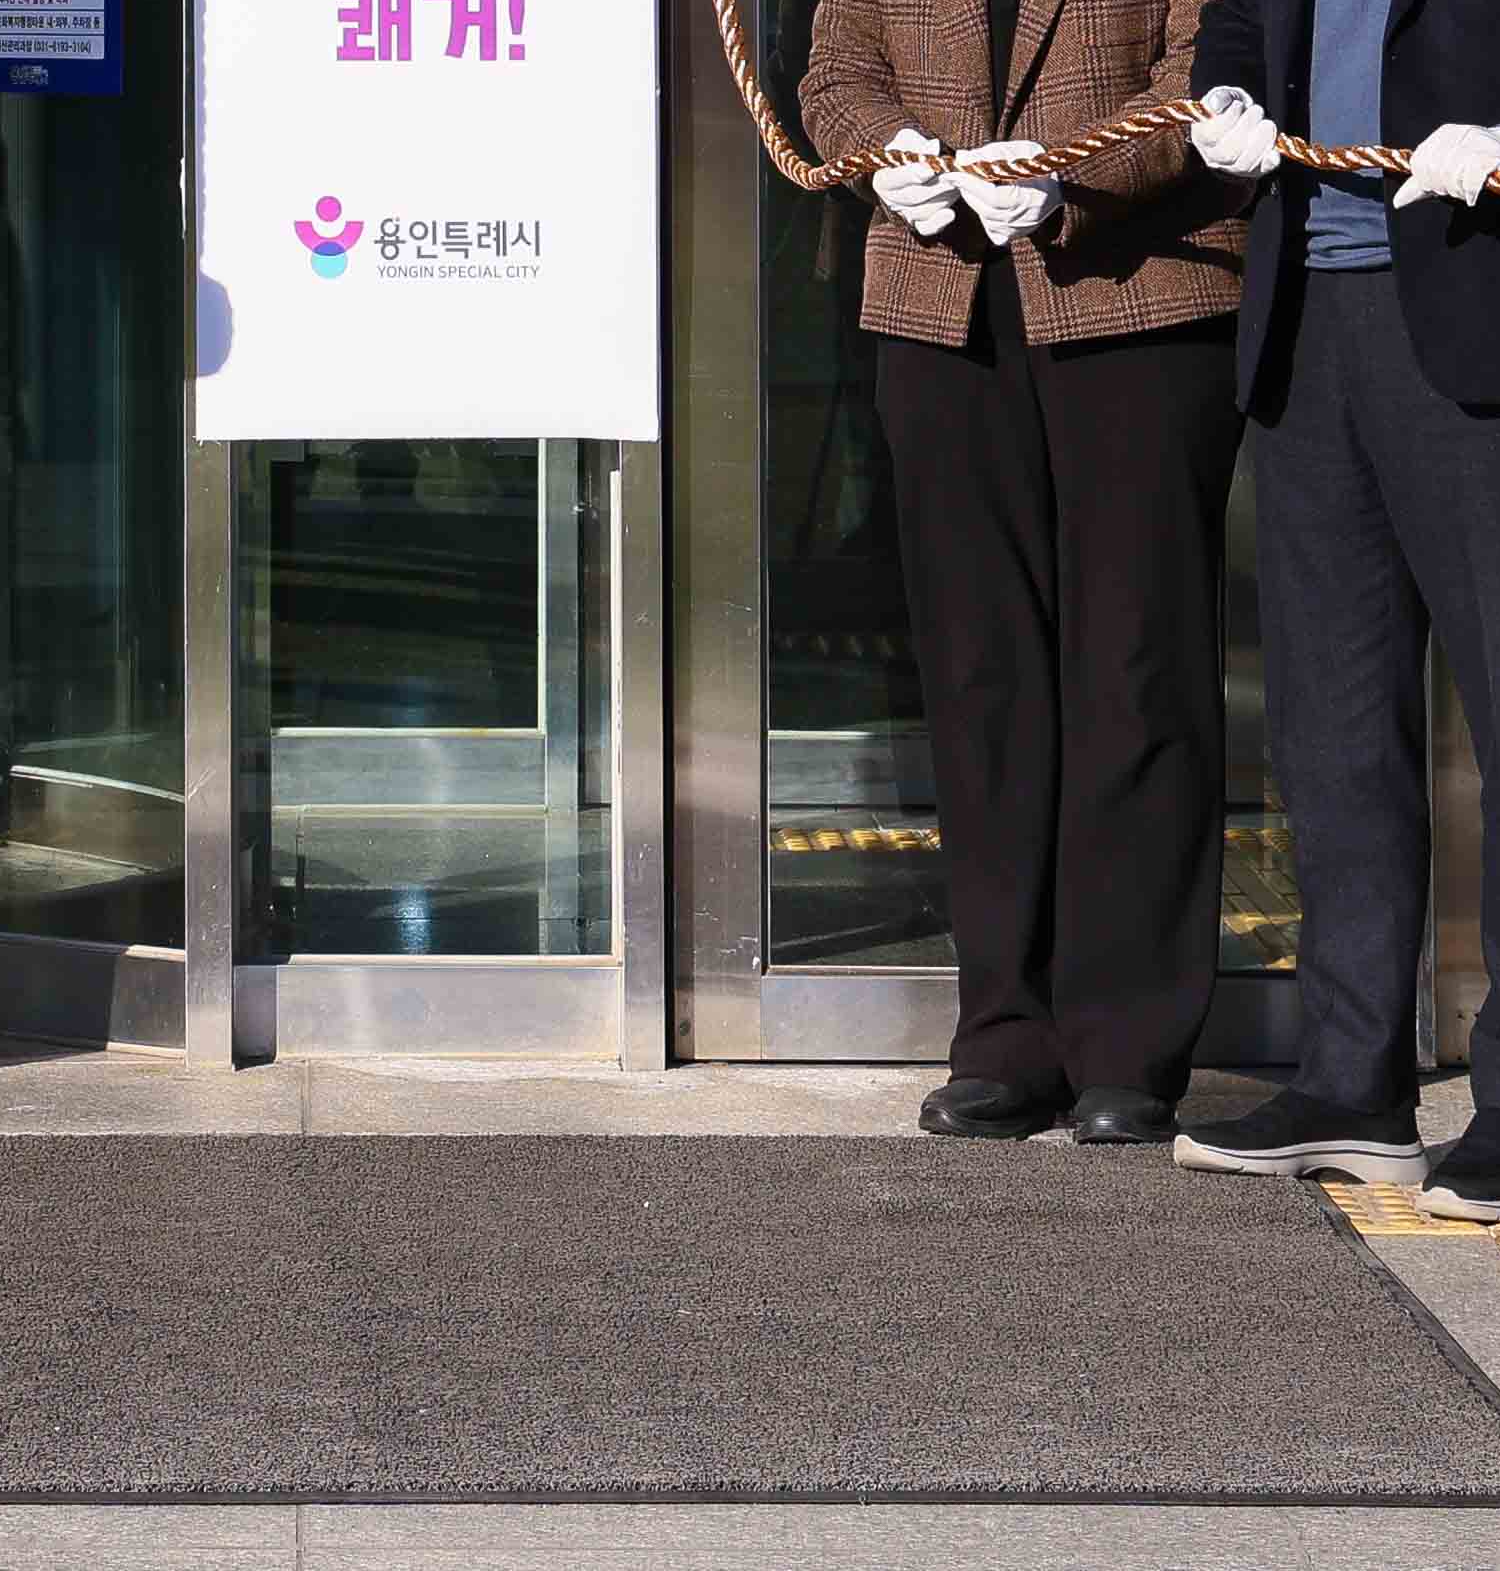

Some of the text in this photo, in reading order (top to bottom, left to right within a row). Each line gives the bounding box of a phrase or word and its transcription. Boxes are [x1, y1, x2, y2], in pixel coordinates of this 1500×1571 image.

[373, 217, 542, 262] 용인특례시
[376, 265, 541, 279] YONGIN SPECIAL CITY
